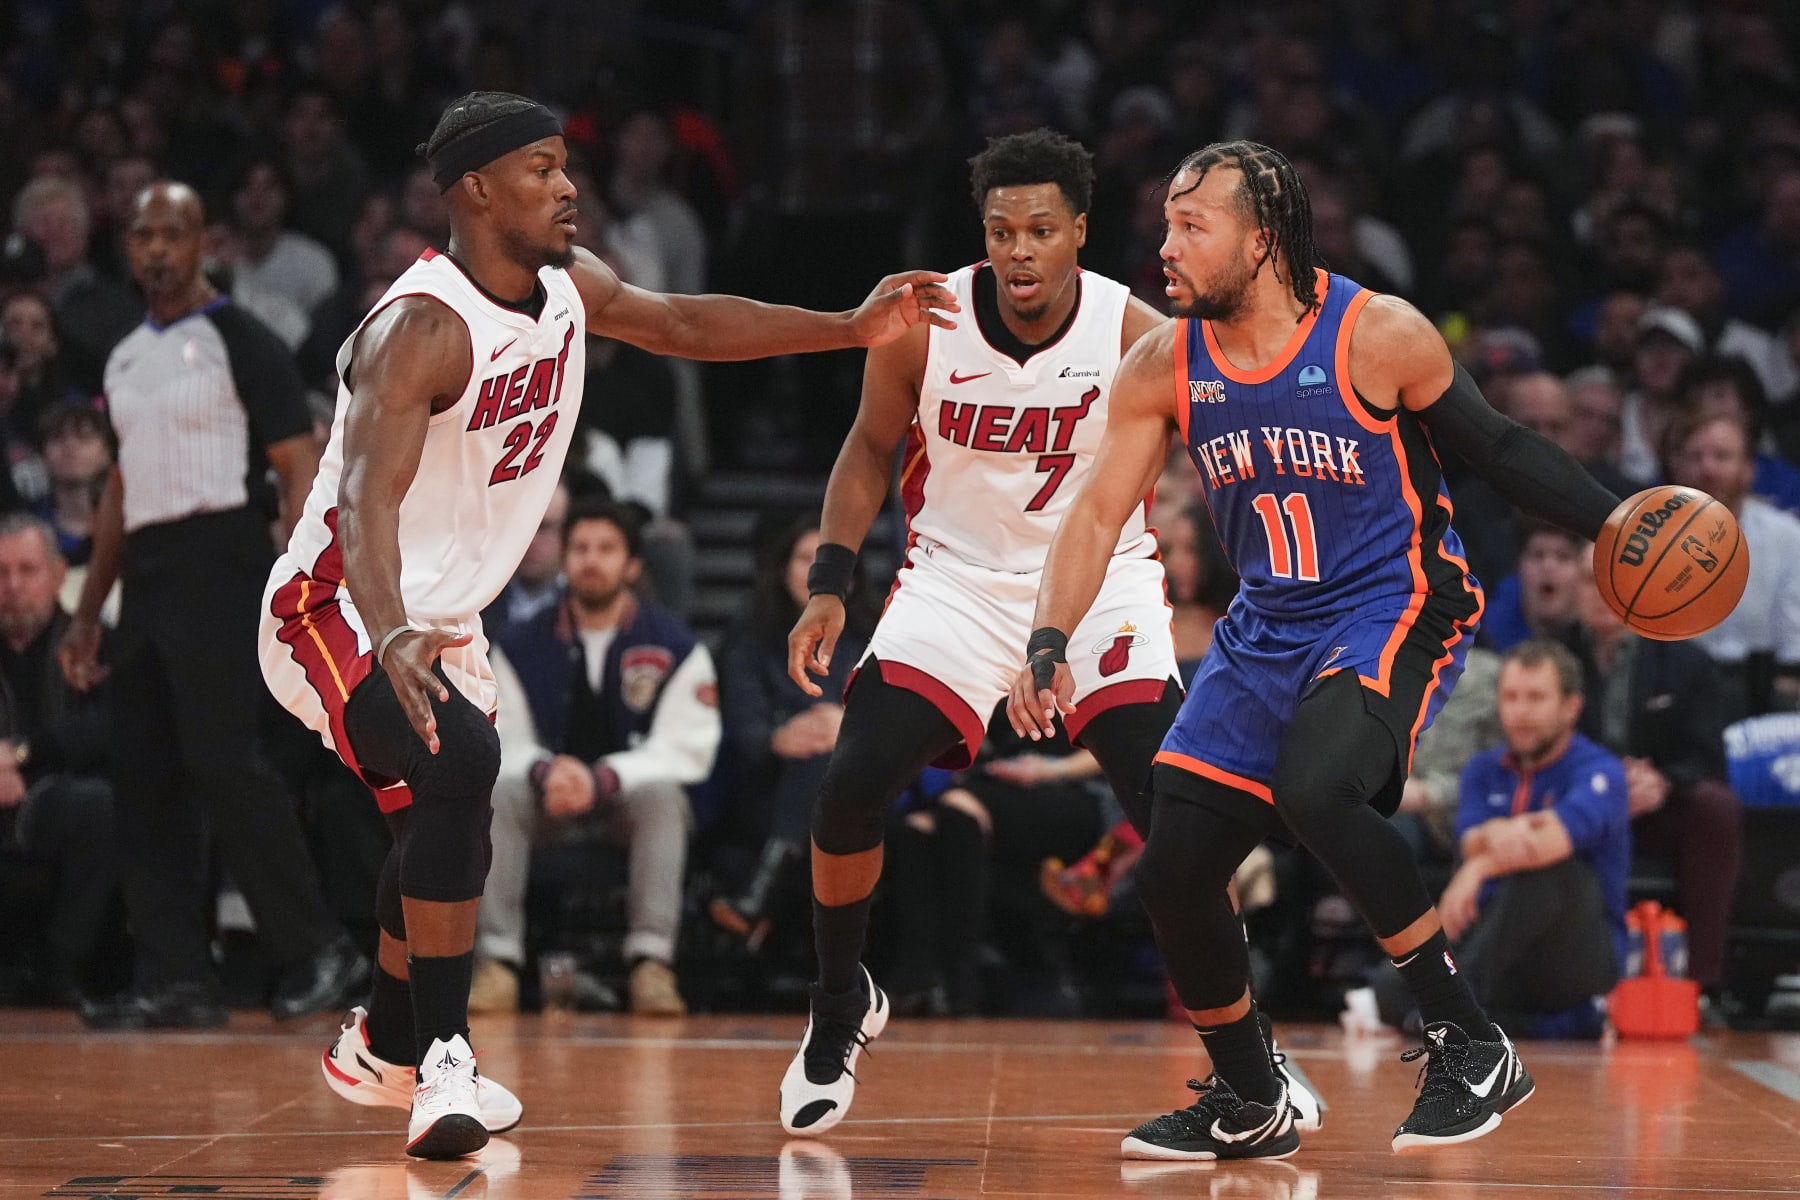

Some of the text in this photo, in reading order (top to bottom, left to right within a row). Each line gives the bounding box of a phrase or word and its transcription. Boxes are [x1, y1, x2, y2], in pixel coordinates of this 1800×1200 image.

[465, 320, 575, 432] HEAT
[1066, 369, 1100, 378] Carnival
[1188, 380, 1226, 403] NYC
[1296, 386, 1333, 399] sphere
[488, 410, 559, 487] 22
[938, 385, 1101, 453] HEAT
[1023, 453, 1077, 512] 7
[1197, 426, 1364, 485] NEW YORK
[1251, 492, 1321, 582] 11
[1619, 493, 1696, 567] Wilson
